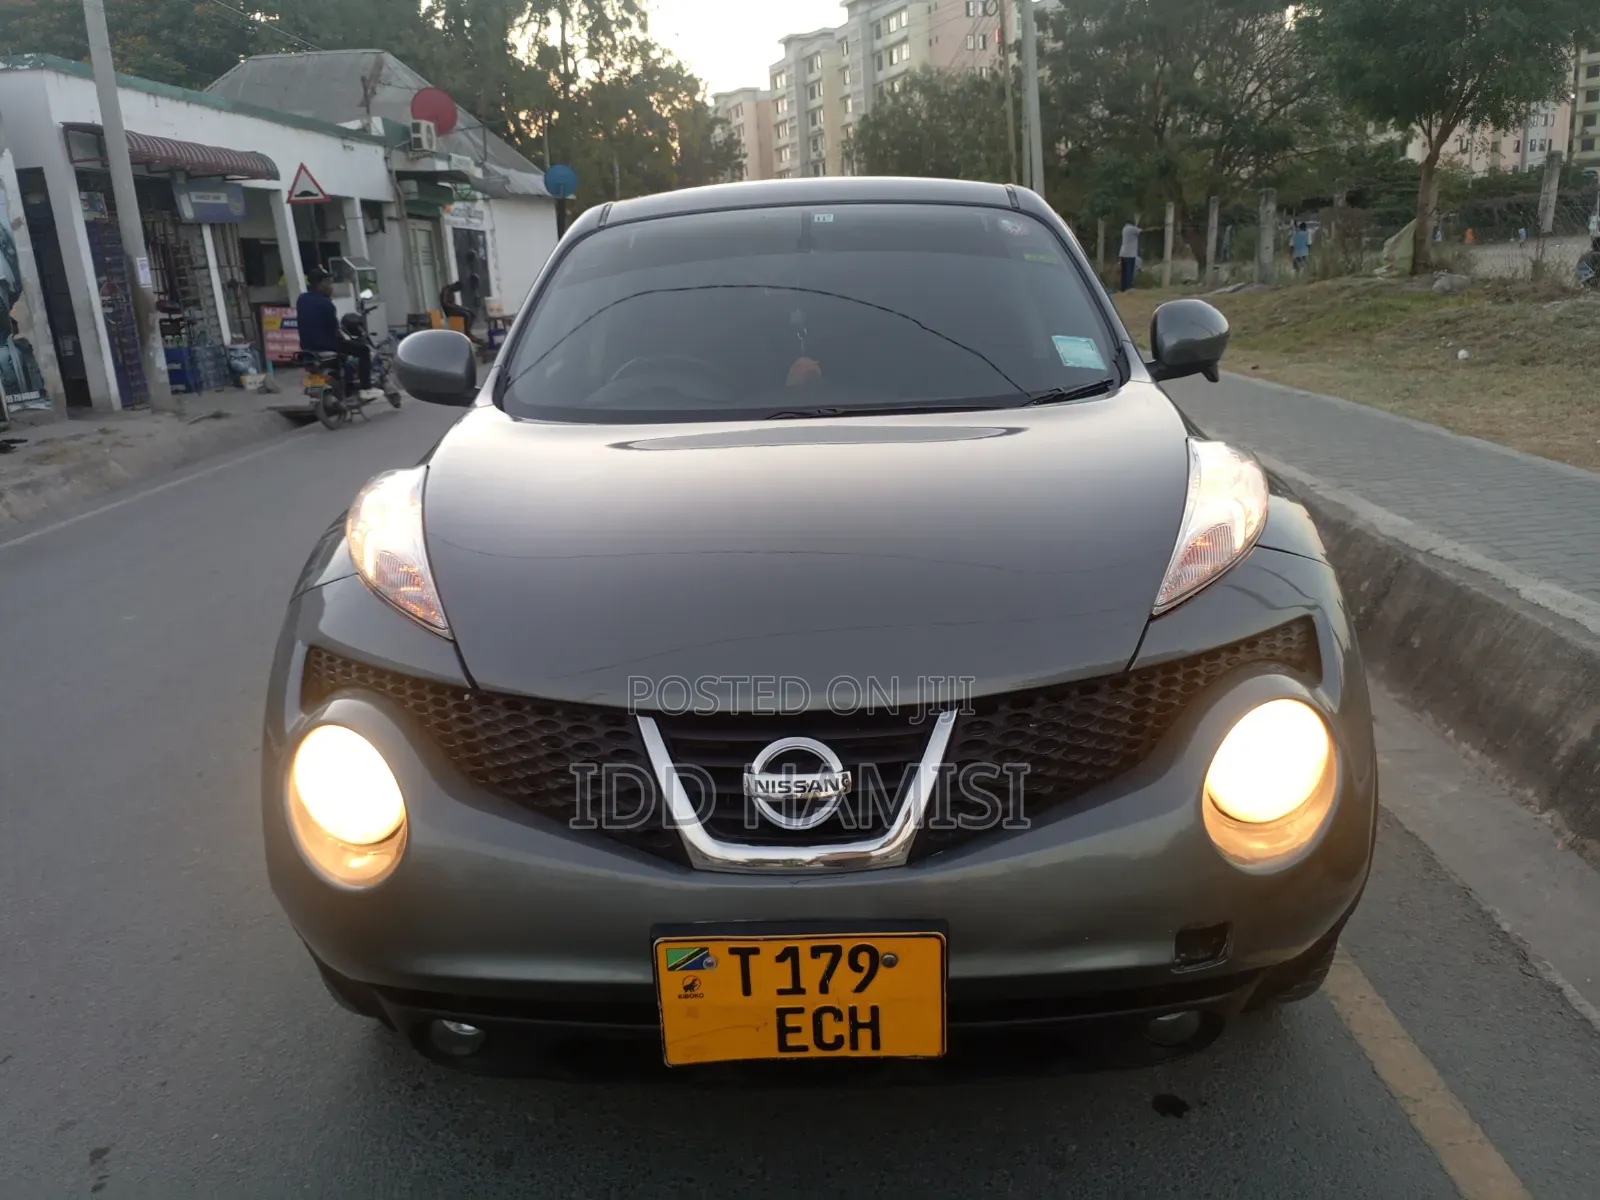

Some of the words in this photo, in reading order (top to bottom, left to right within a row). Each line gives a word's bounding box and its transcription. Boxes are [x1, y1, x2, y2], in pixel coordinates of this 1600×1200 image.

[755, 778, 840, 794] NISSAN
[728, 946, 760, 997] T
[775, 943, 880, 996] 179
[776, 1004, 881, 1053] ECH
